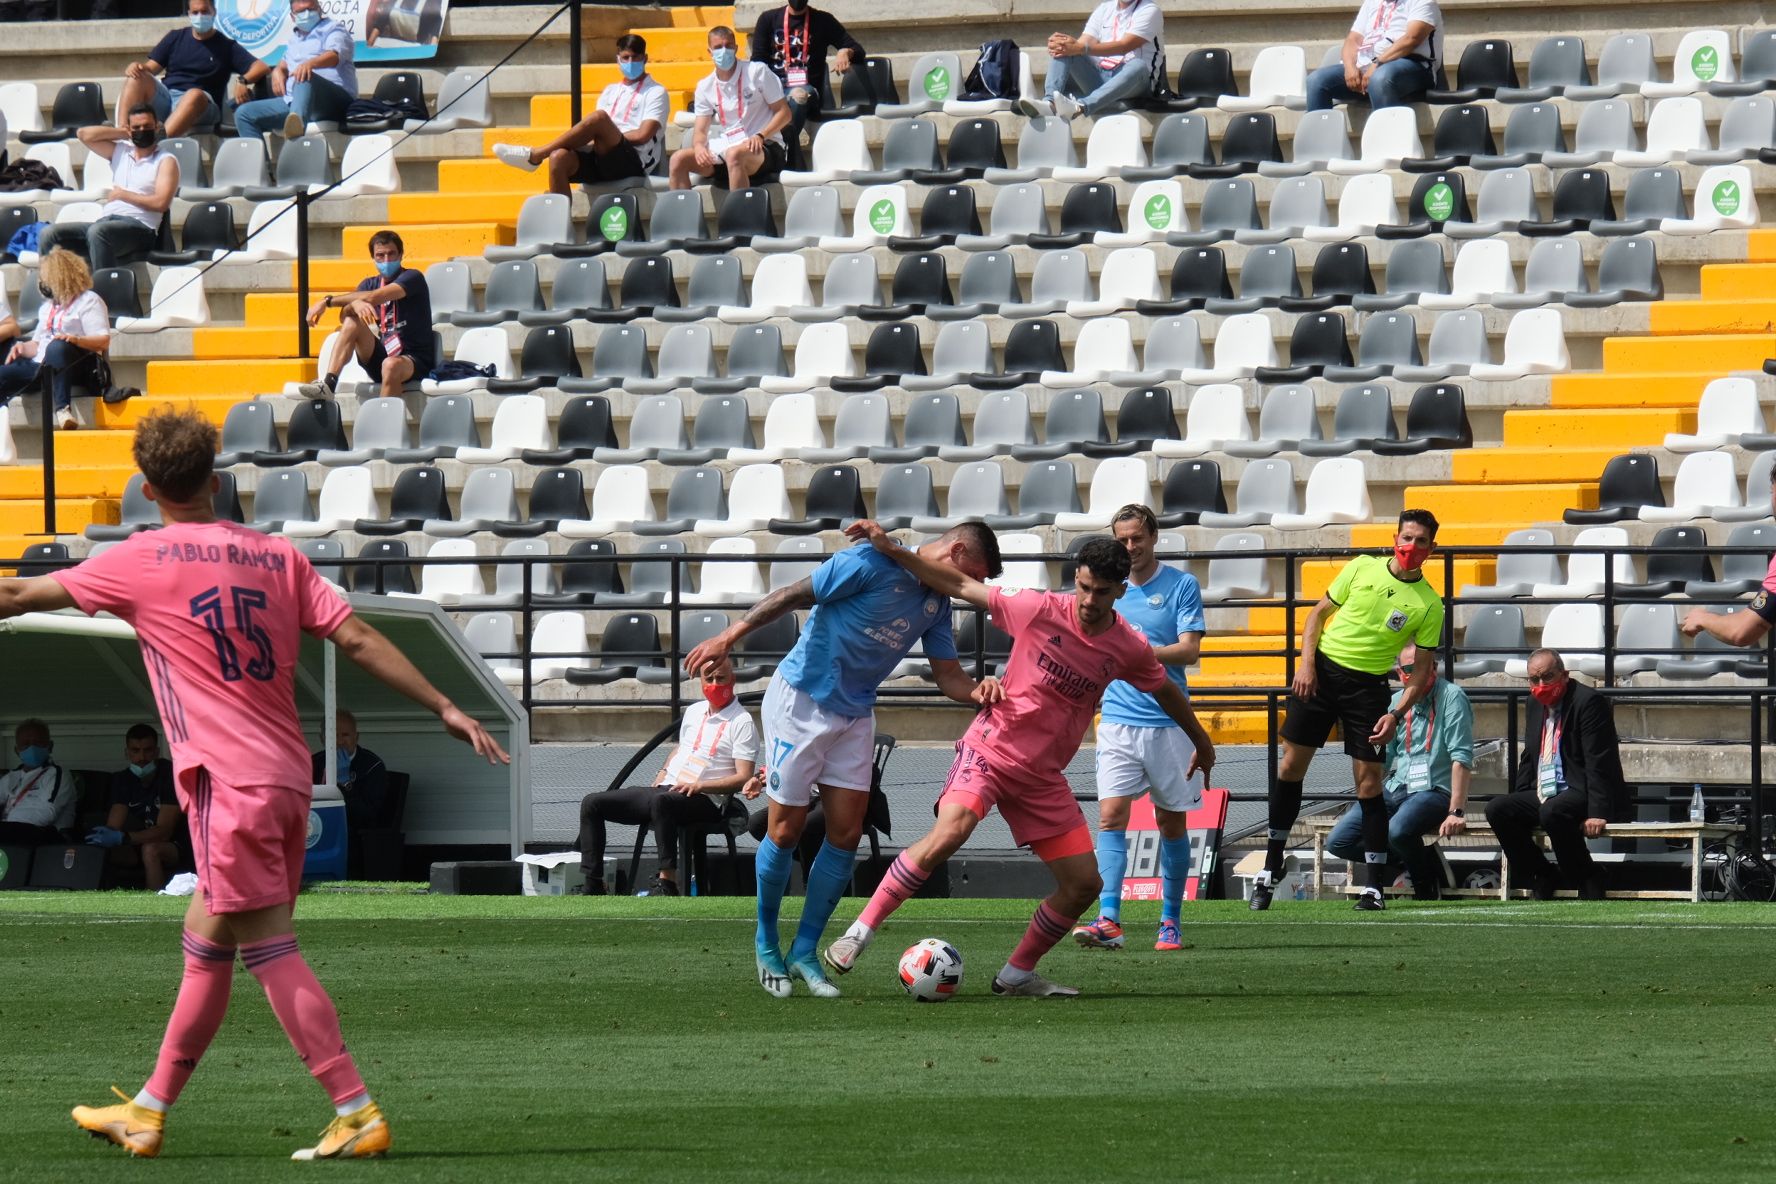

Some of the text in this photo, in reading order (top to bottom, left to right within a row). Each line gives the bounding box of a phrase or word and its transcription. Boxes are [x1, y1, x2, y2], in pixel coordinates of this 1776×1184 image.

[319, 0, 360, 15] OCIA
[156, 543, 221, 565] PABLO
[189, 585, 277, 682] 15
[1036, 651, 1099, 693] Emirates
[773, 736, 795, 769] 17
